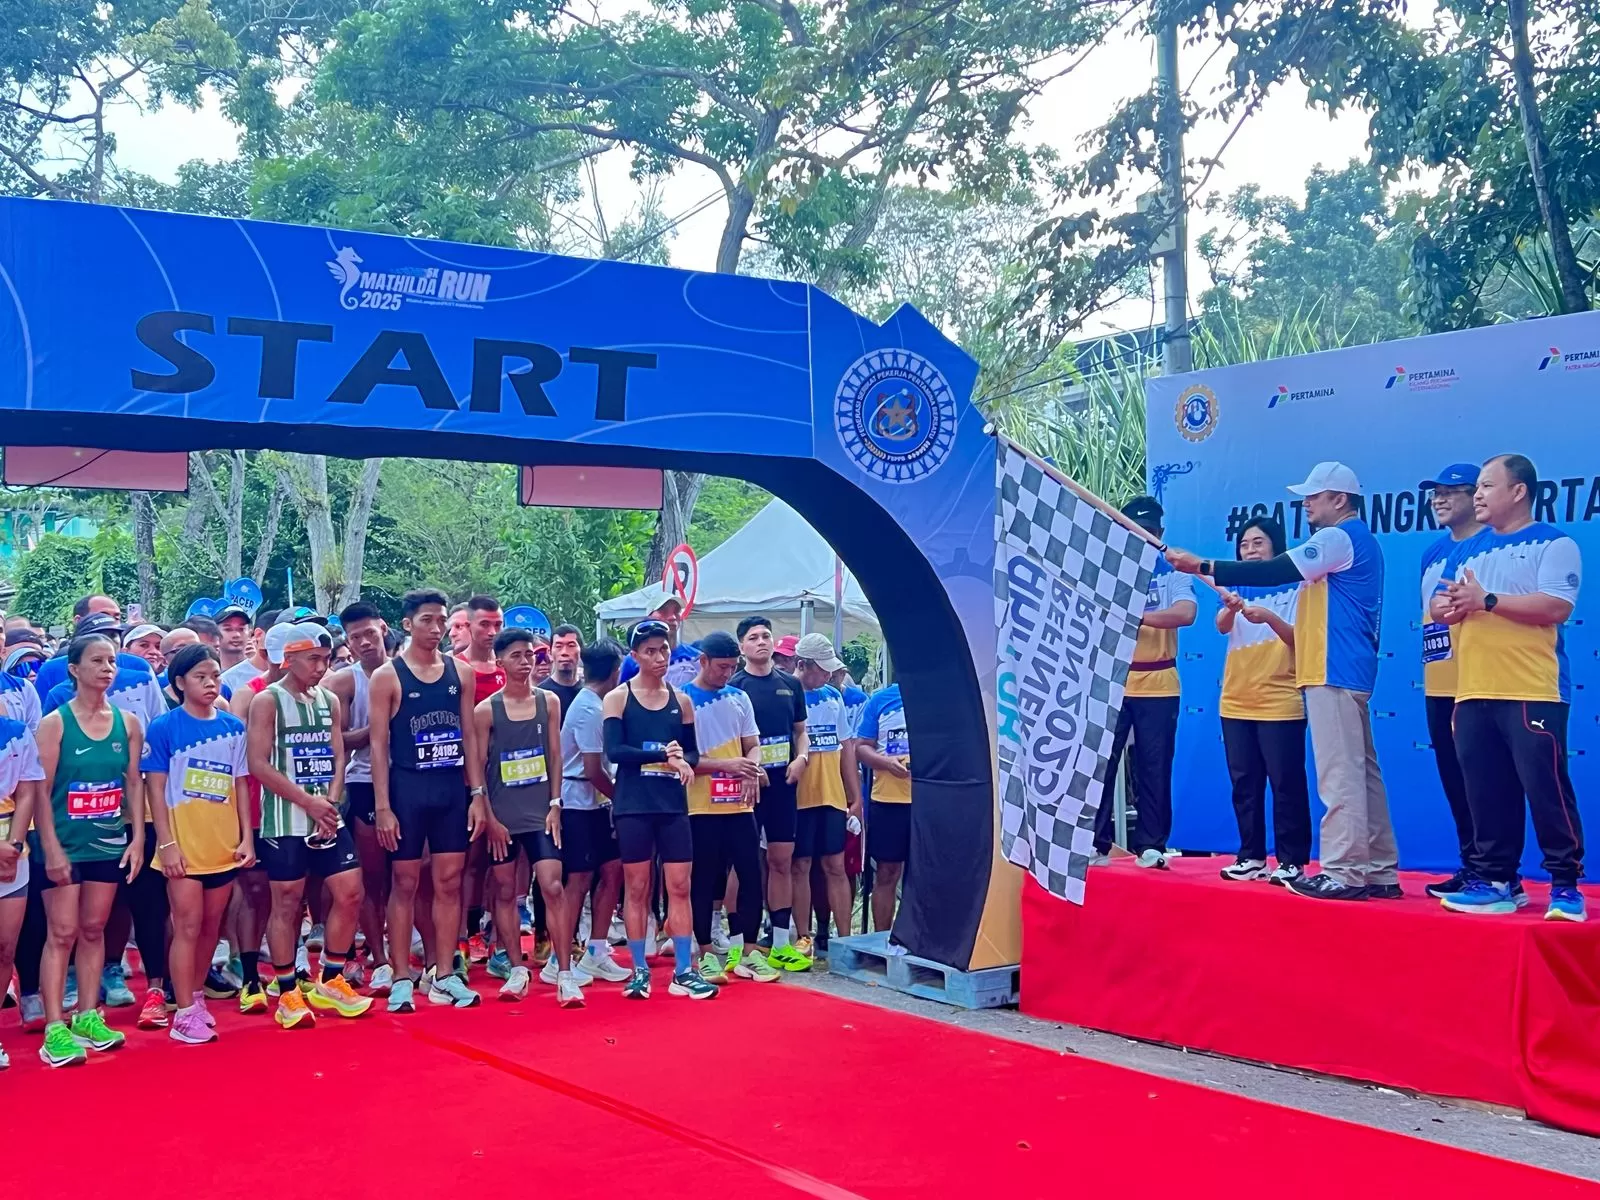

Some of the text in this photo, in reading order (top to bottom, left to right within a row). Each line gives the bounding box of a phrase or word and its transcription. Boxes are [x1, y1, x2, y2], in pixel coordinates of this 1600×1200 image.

[359, 269, 492, 302] MATHILDA RUN
[359, 291, 403, 311] 2025
[129, 310, 659, 422] START
[1408, 368, 1456, 381] PERTAMINA
[1290, 387, 1335, 401] PERTAMINA
